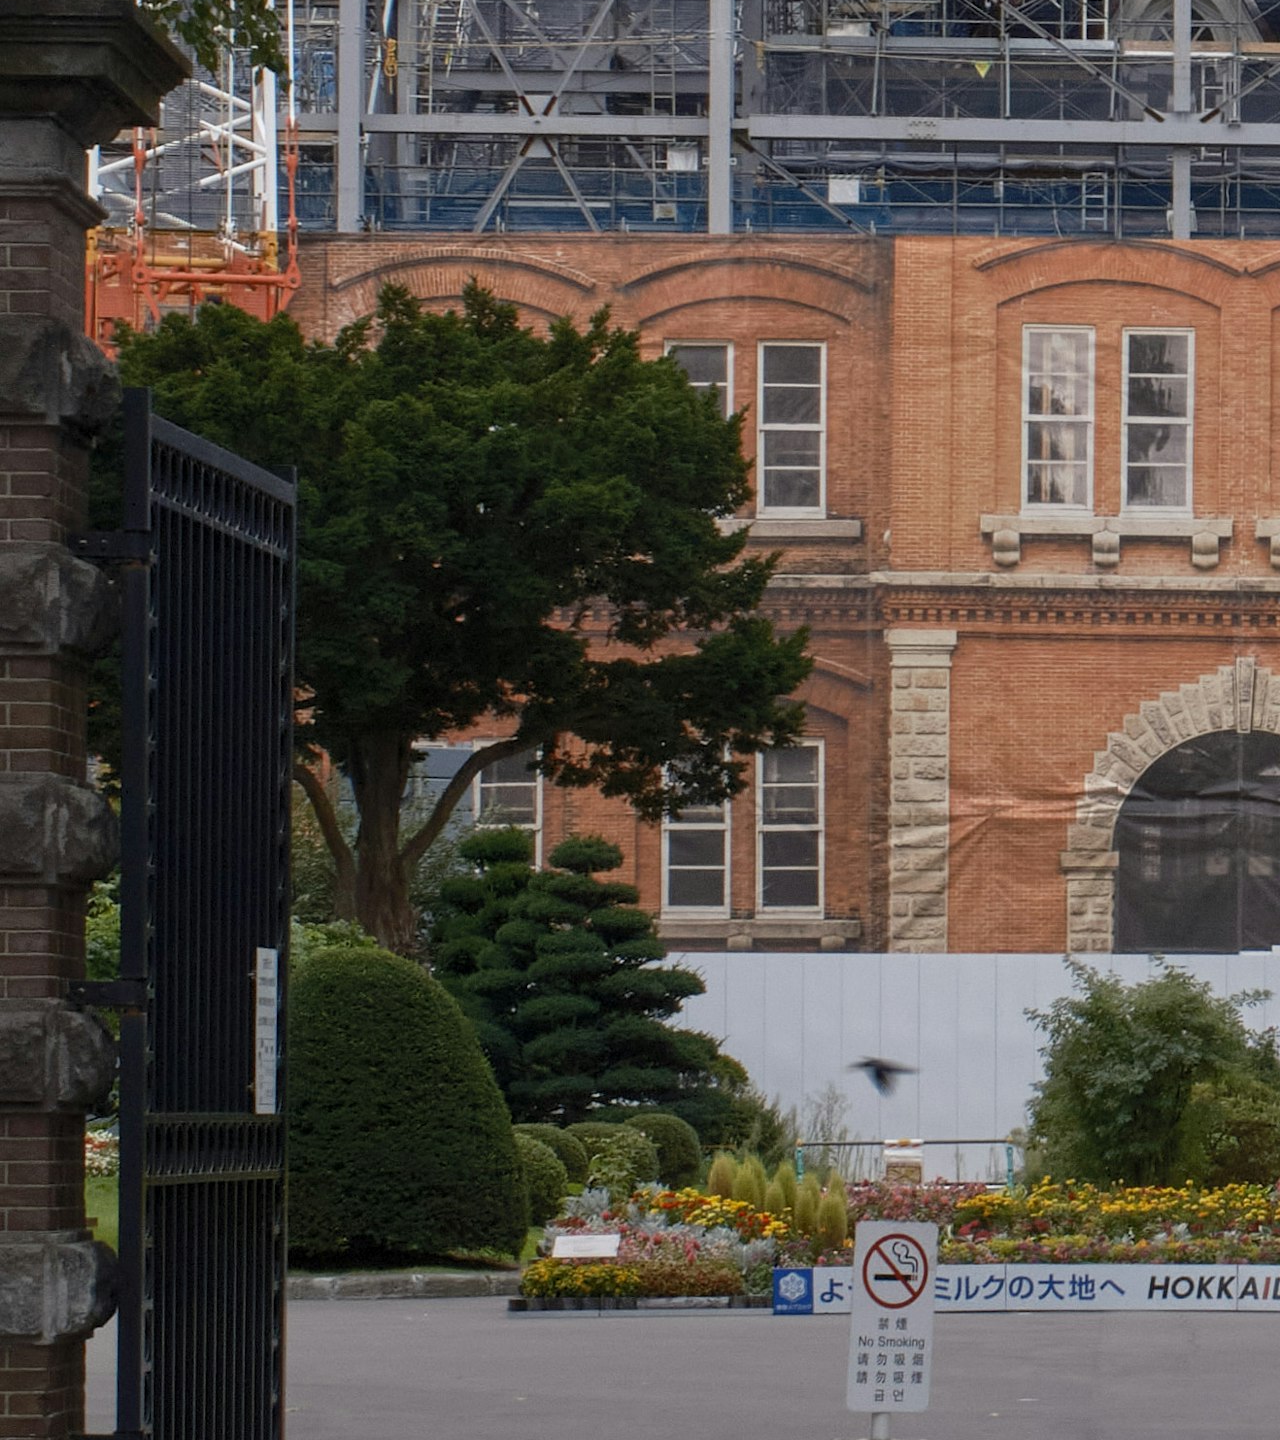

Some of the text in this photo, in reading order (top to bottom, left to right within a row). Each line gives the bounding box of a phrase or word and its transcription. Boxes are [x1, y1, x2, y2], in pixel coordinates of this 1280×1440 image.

[878, 1317, 908, 1331] 禁煙
[858, 1335, 926, 1351] No Smoking
